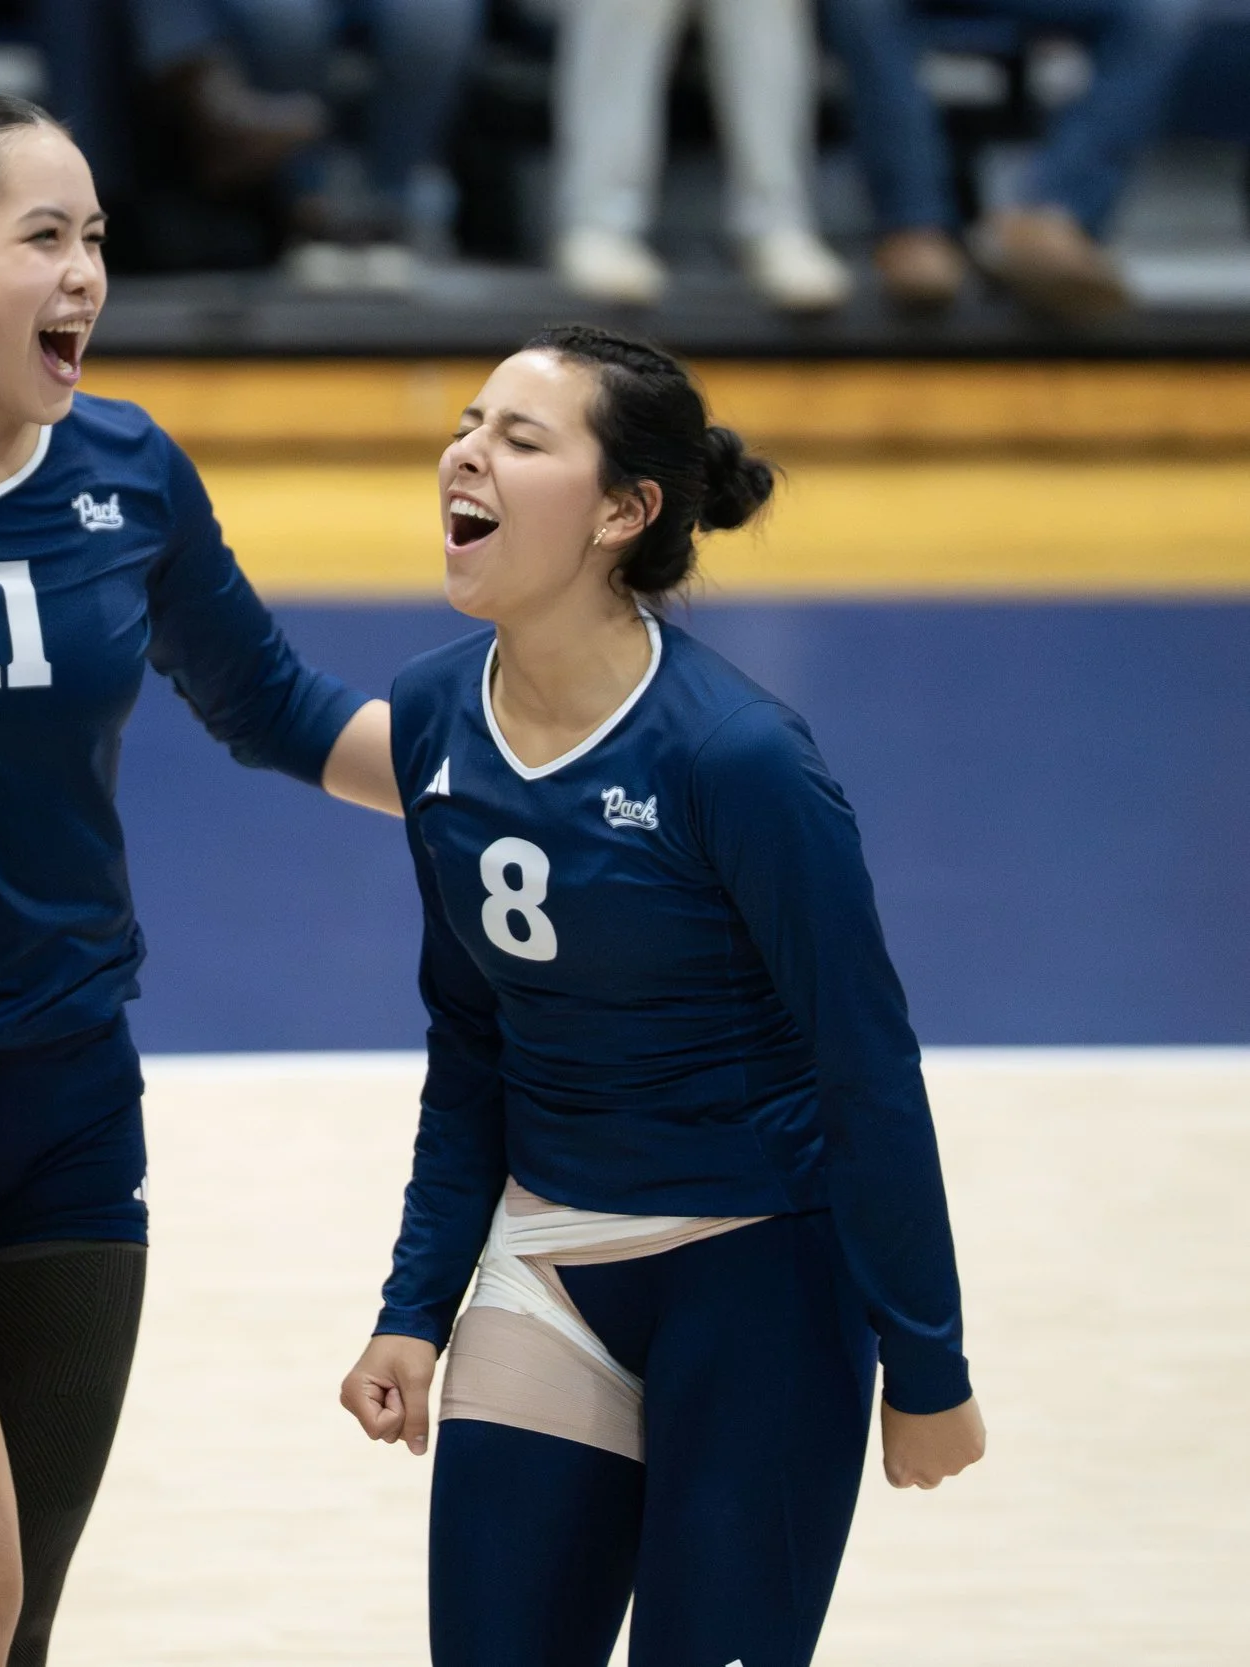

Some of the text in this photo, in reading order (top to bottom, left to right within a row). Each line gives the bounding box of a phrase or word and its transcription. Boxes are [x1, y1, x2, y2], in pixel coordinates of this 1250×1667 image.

[71, 491, 124, 532] Pack
[601, 786, 659, 830] Pack
[480, 836, 558, 962] 8
